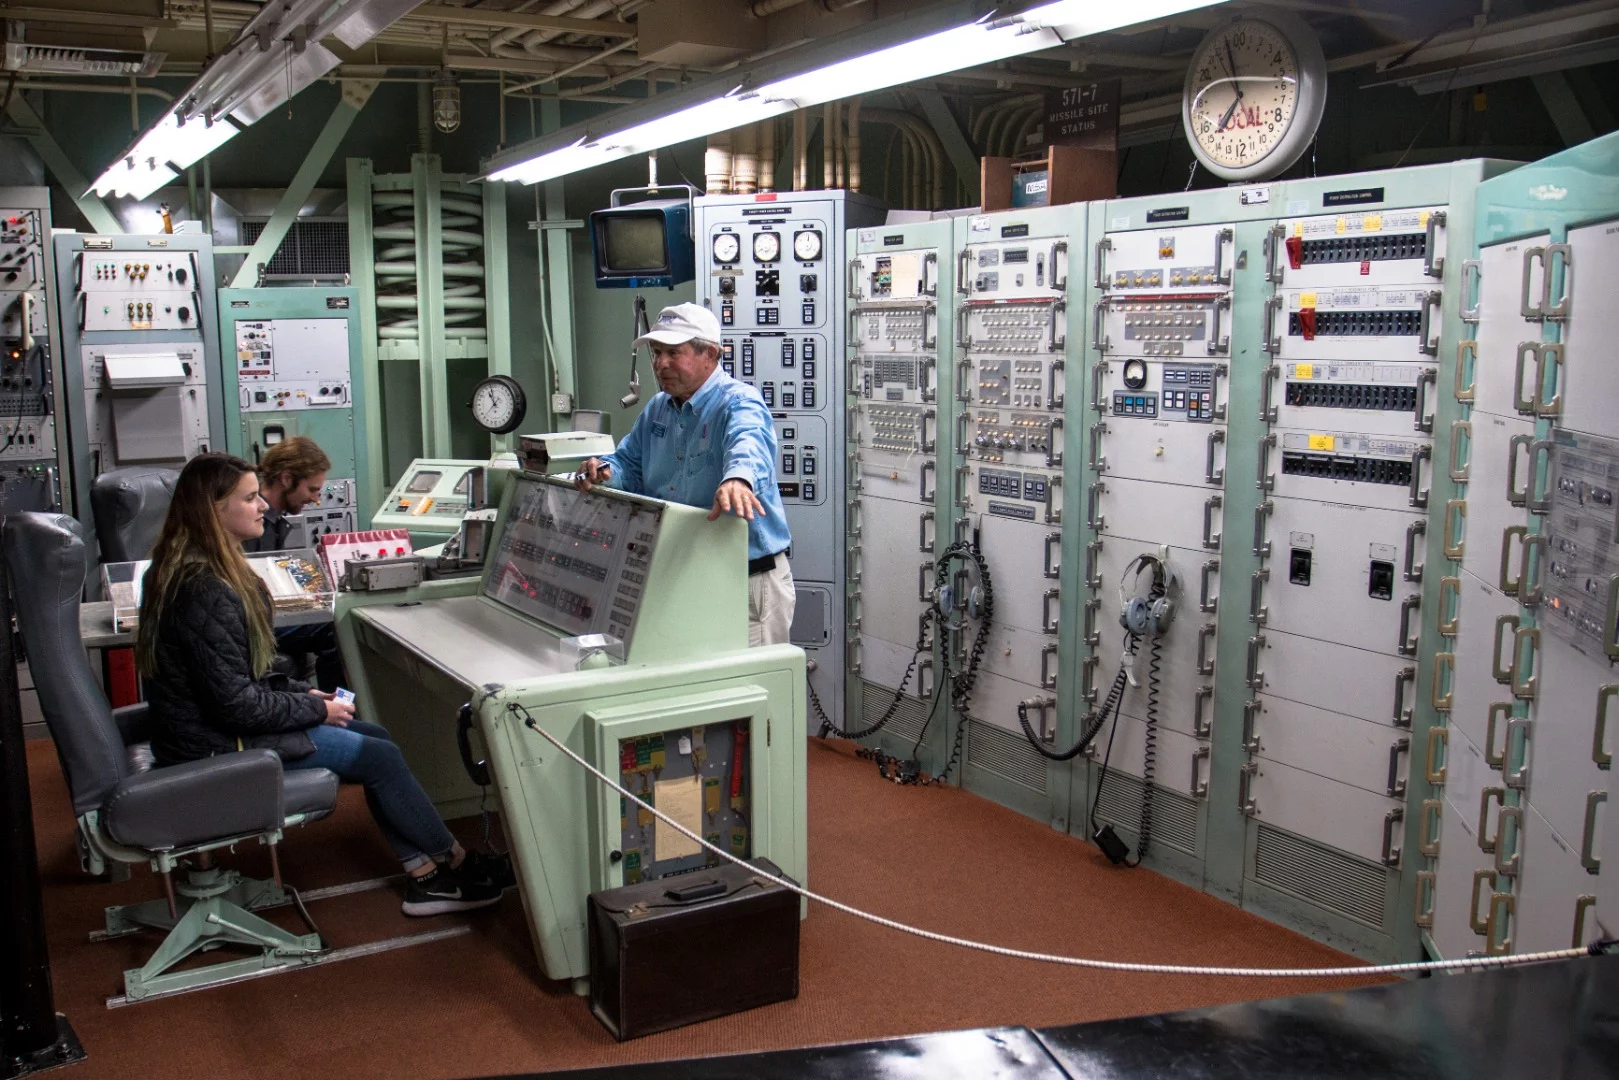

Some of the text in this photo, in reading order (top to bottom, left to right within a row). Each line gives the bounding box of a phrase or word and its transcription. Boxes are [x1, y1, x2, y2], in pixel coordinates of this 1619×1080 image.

[1233, 31, 1246, 48] 00
[1258, 36, 1264, 47] 2
[1268, 43, 1273, 54] 3
[1274, 51, 1282, 63] 4
[1199, 67, 1210, 82] 20
[1279, 68, 1286, 77] 5
[1280, 81, 1287, 91] 6
[1063, 84, 1097, 106] 571-7
[1280, 95, 1286, 104] 7
[1196, 98, 1204, 108] 18
[1049, 103, 1108, 122] MISSILE SITE
[1274, 107, 1283, 123] 8
[1218, 105, 1263, 133] LOCAL
[1061, 121, 1095, 134] STATUS
[1200, 121, 1210, 134] 16
[1267, 122, 1274, 133] 9
[1207, 134, 1215, 144] 15
[1258, 134, 1267, 144] 10
[1215, 142, 1222, 152] 14
[1225, 145, 1232, 155] 13
[1235, 142, 1246, 158] 12
[1249, 141, 1255, 151] 11
